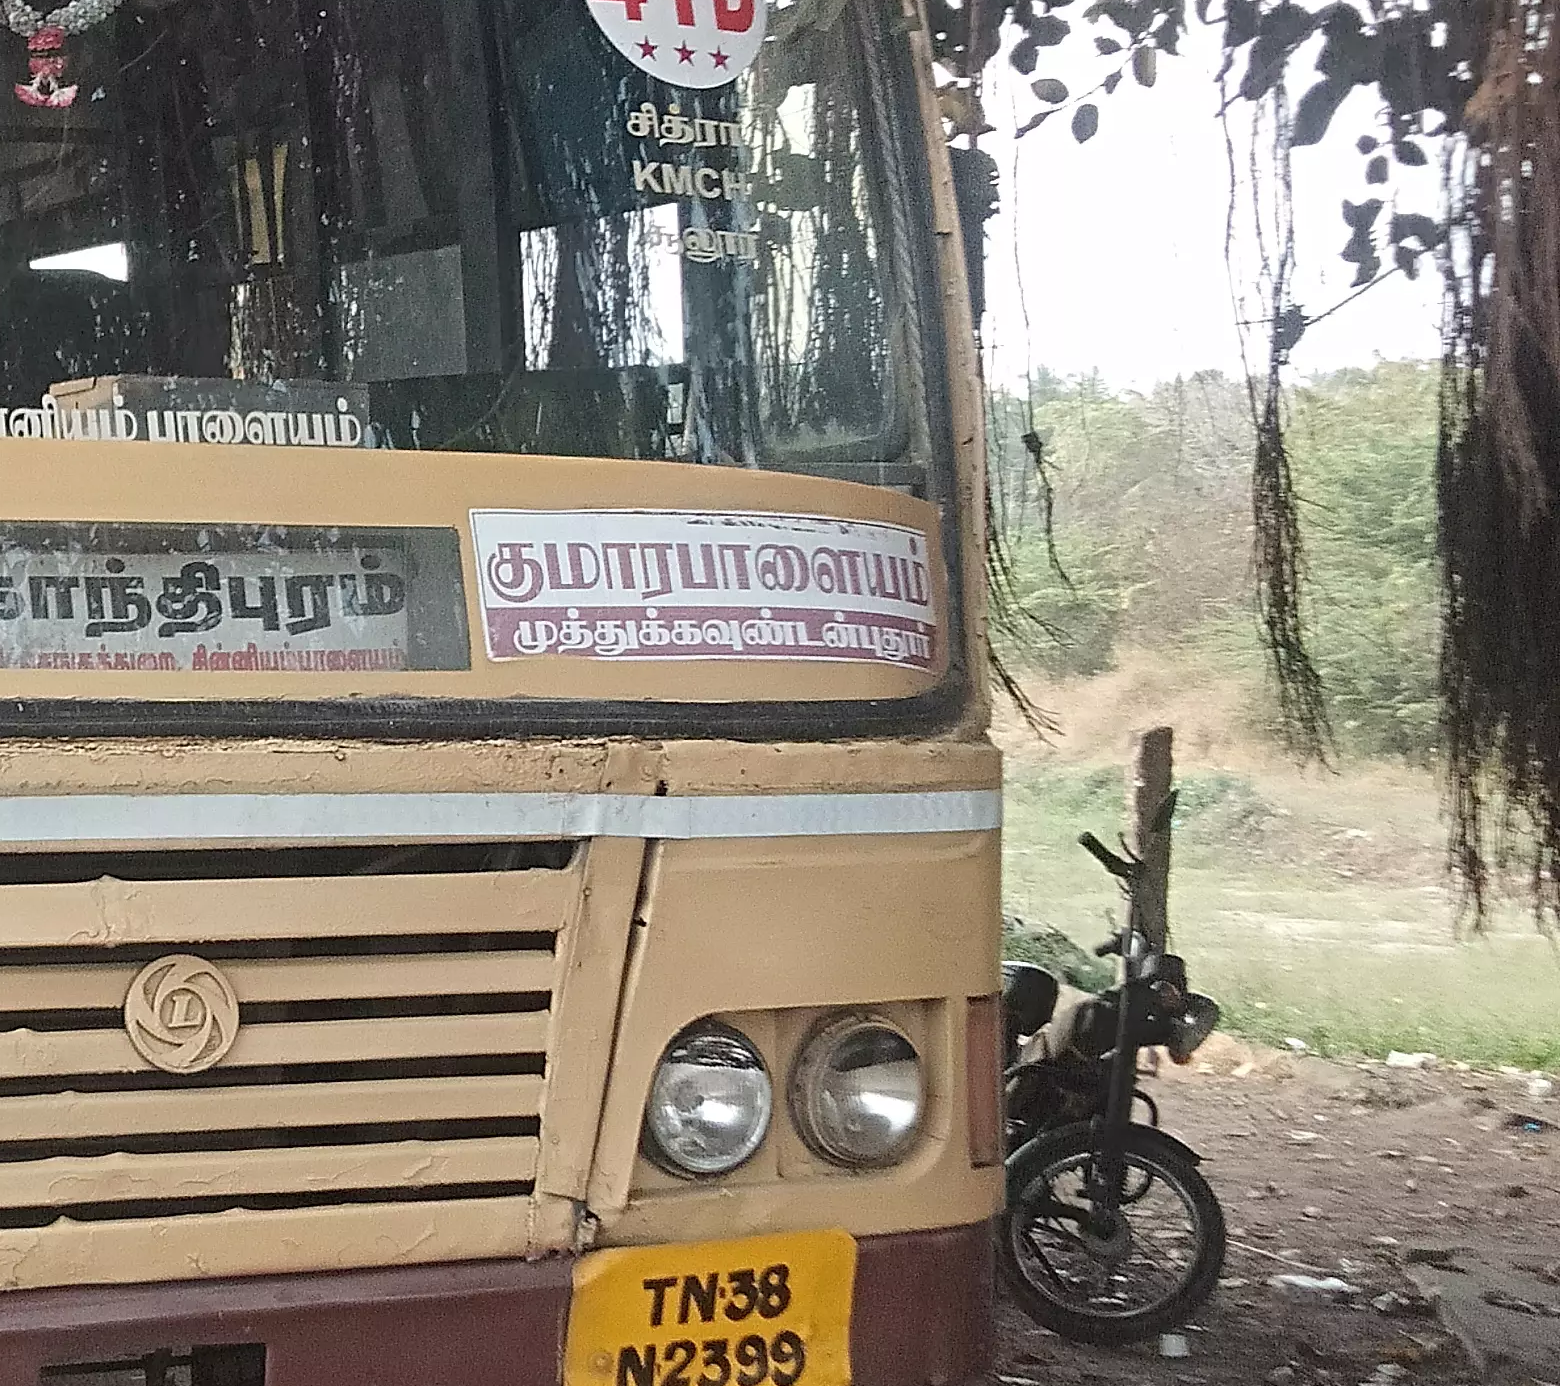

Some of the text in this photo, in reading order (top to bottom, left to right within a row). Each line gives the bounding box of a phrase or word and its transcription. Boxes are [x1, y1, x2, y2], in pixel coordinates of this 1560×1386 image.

[626, 102, 740, 148] சித்ரா
[631, 160, 753, 201] KMCH
[487, 535, 929, 607] குமாரபாளையம்
